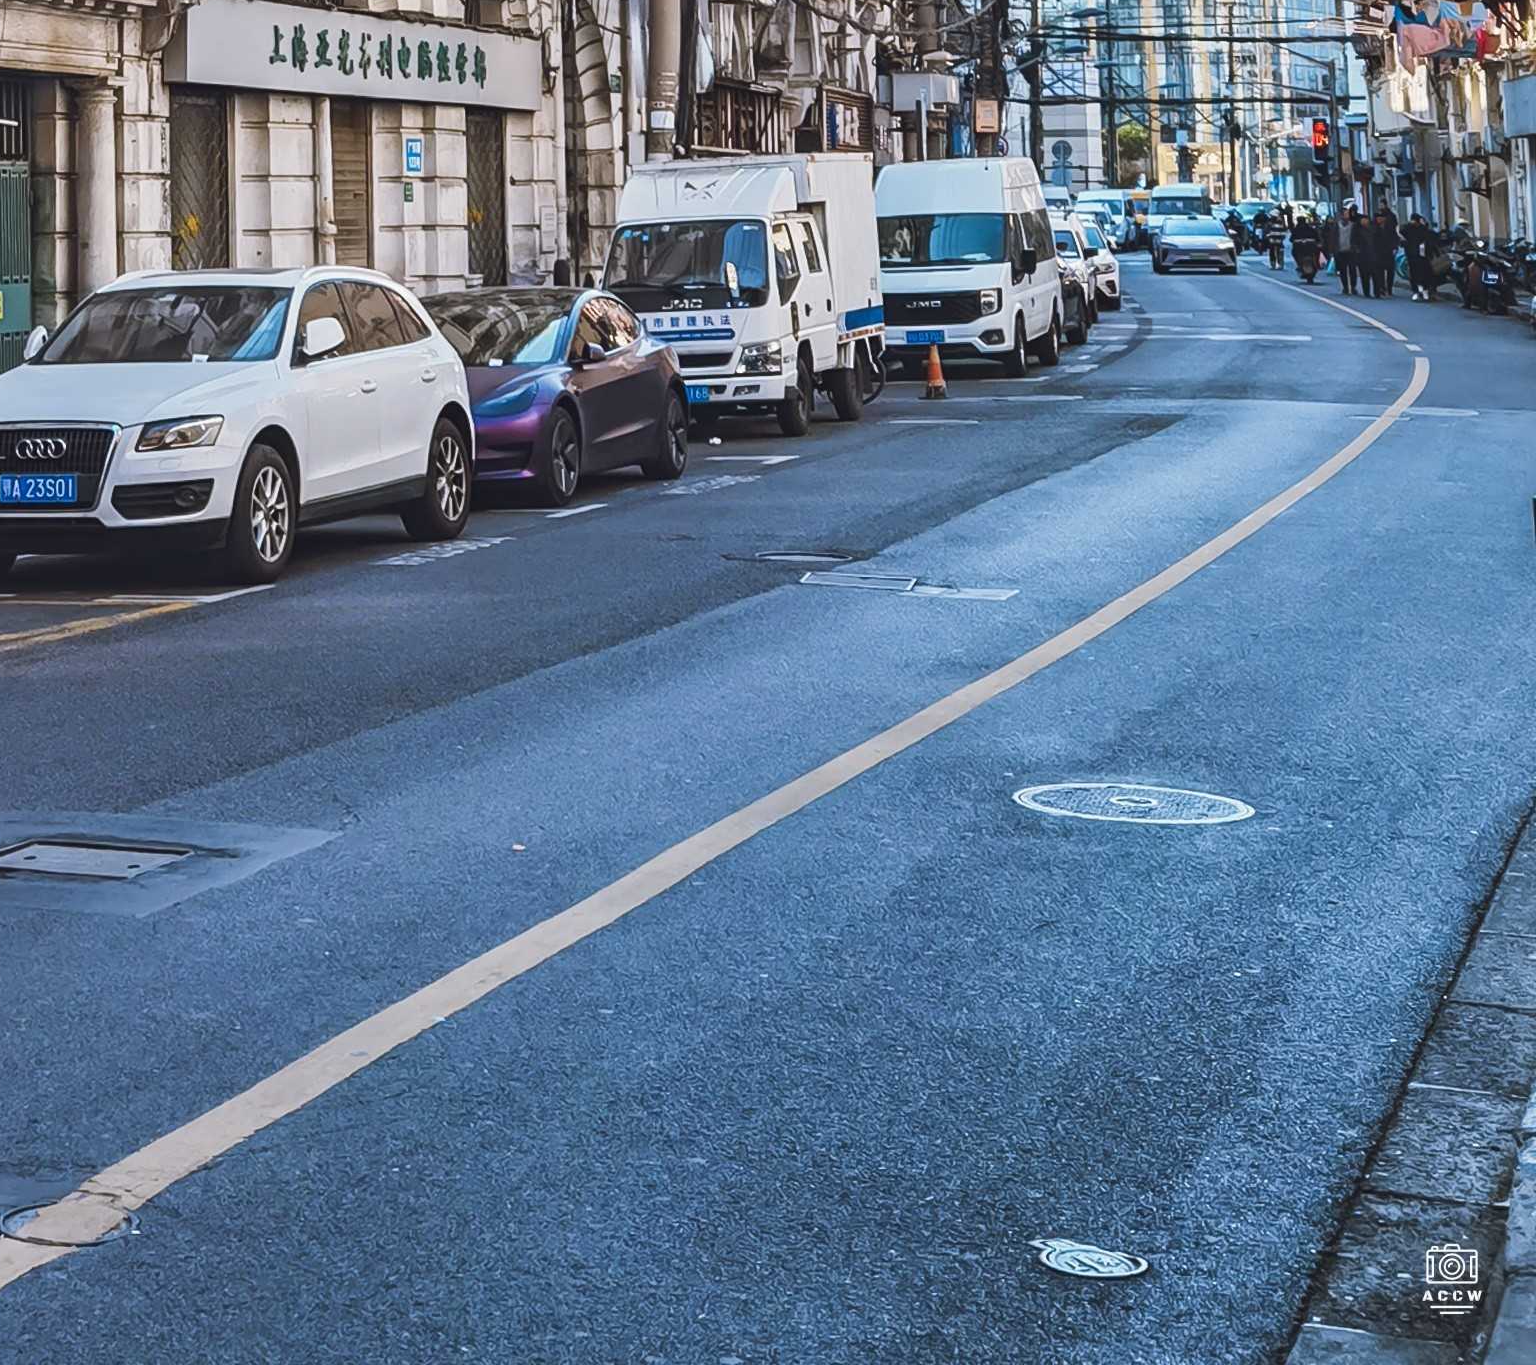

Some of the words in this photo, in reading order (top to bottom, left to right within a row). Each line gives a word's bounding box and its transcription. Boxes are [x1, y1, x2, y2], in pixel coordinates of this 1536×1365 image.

[642, 315, 733, 329] 市管理执法
